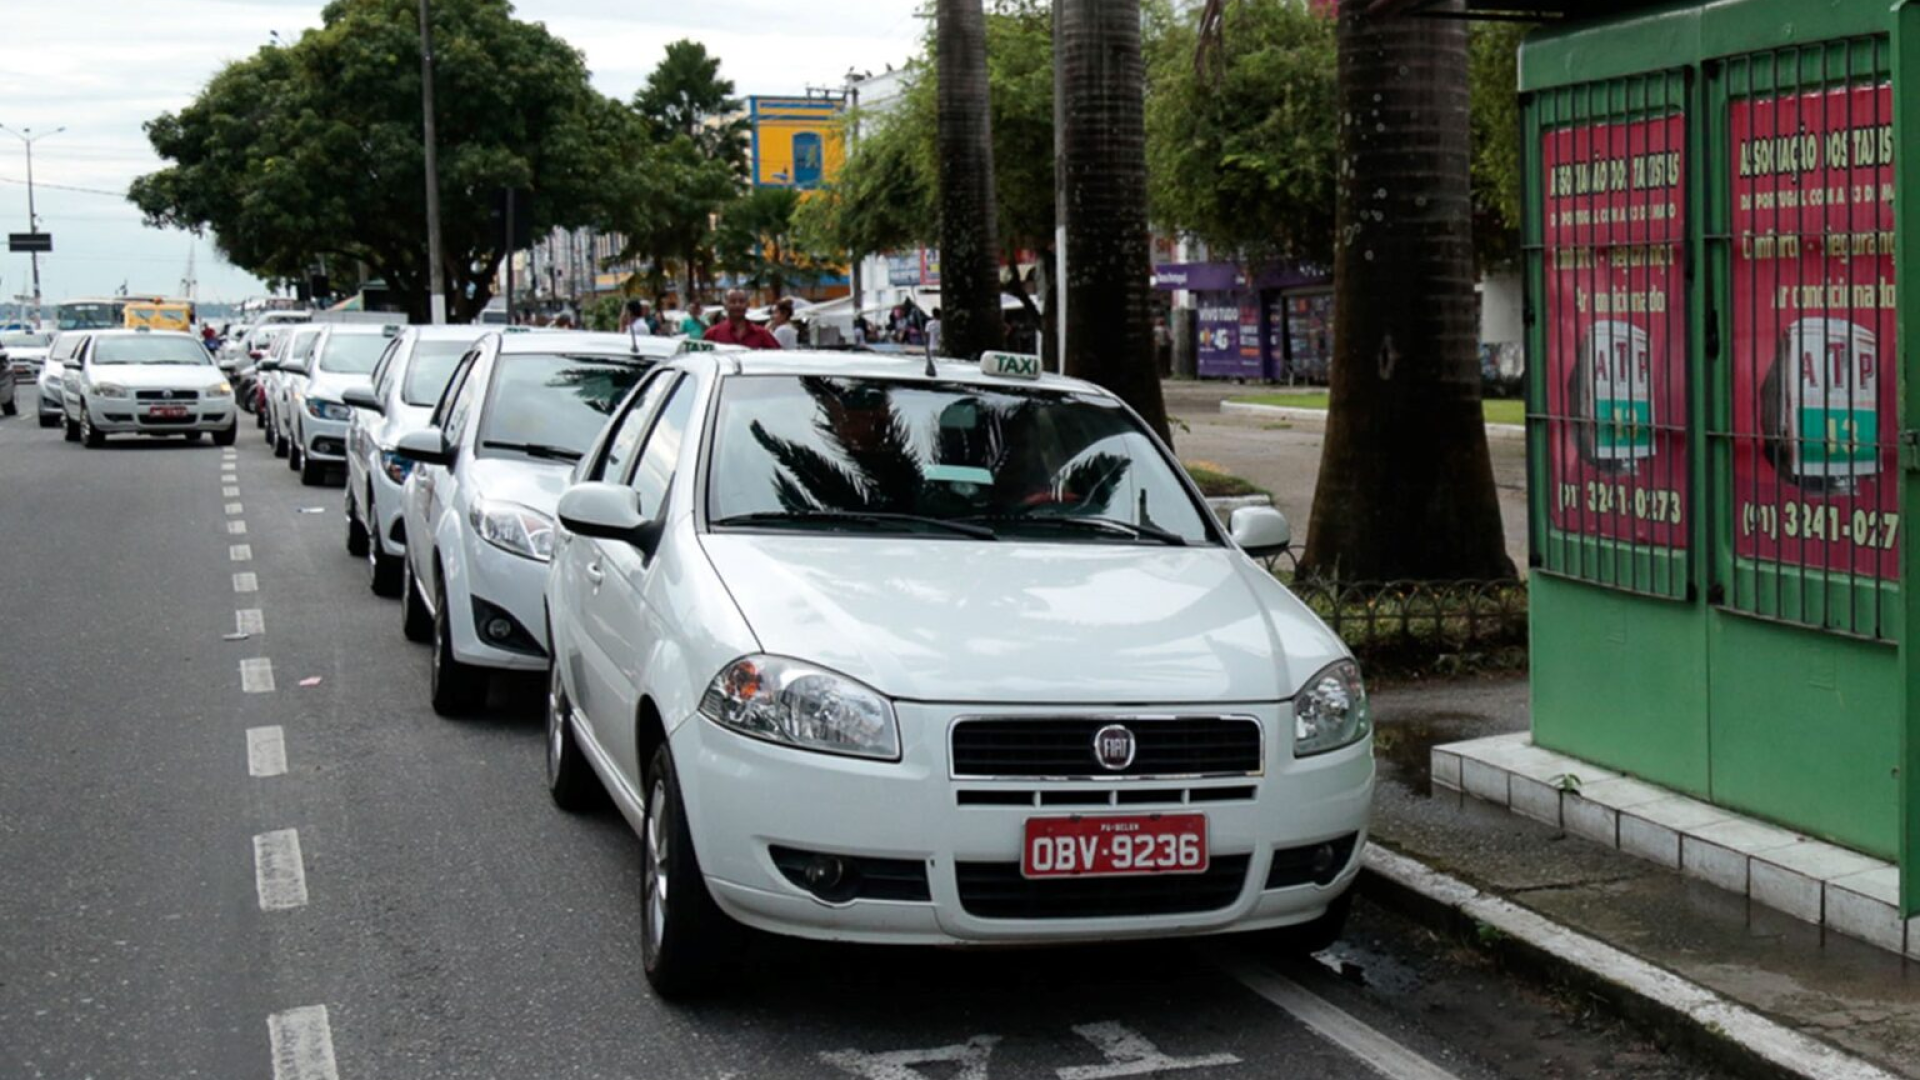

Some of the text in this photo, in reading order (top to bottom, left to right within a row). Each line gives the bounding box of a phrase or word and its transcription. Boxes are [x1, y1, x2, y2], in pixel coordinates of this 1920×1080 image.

[994, 354, 1038, 375] TAXI
[1596, 342, 1649, 383] ATP
[1803, 341, 1878, 389] ATP
[1827, 417, 1860, 455] 13
[1104, 738, 1128, 757] FIAT
